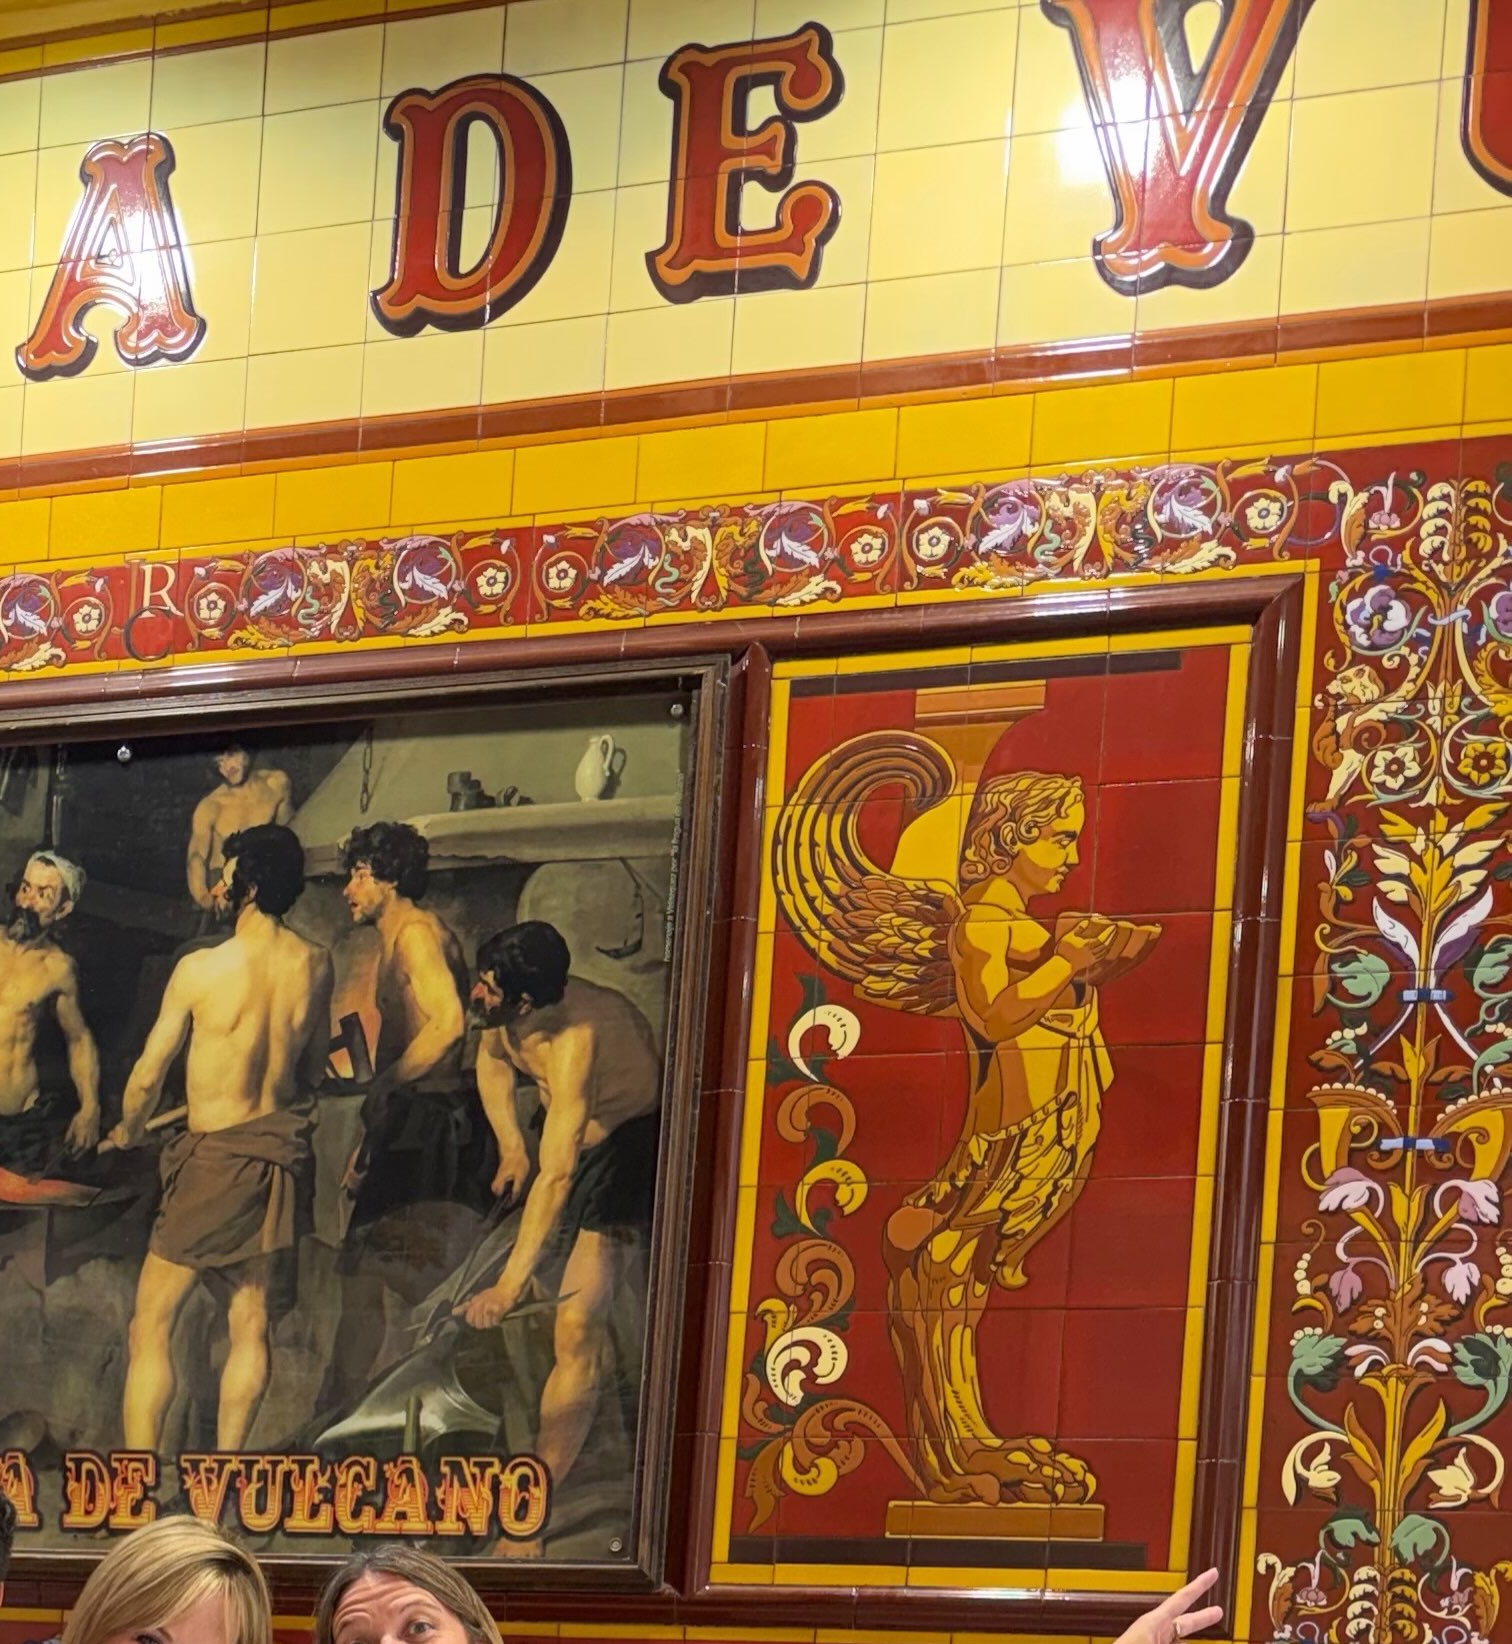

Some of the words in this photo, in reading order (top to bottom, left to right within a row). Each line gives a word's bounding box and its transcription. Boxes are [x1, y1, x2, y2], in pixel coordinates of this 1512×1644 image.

[370, 22, 845, 337] DE
[61, 1452, 158, 1530] DE
[179, 1453, 550, 1537] VULCANO
